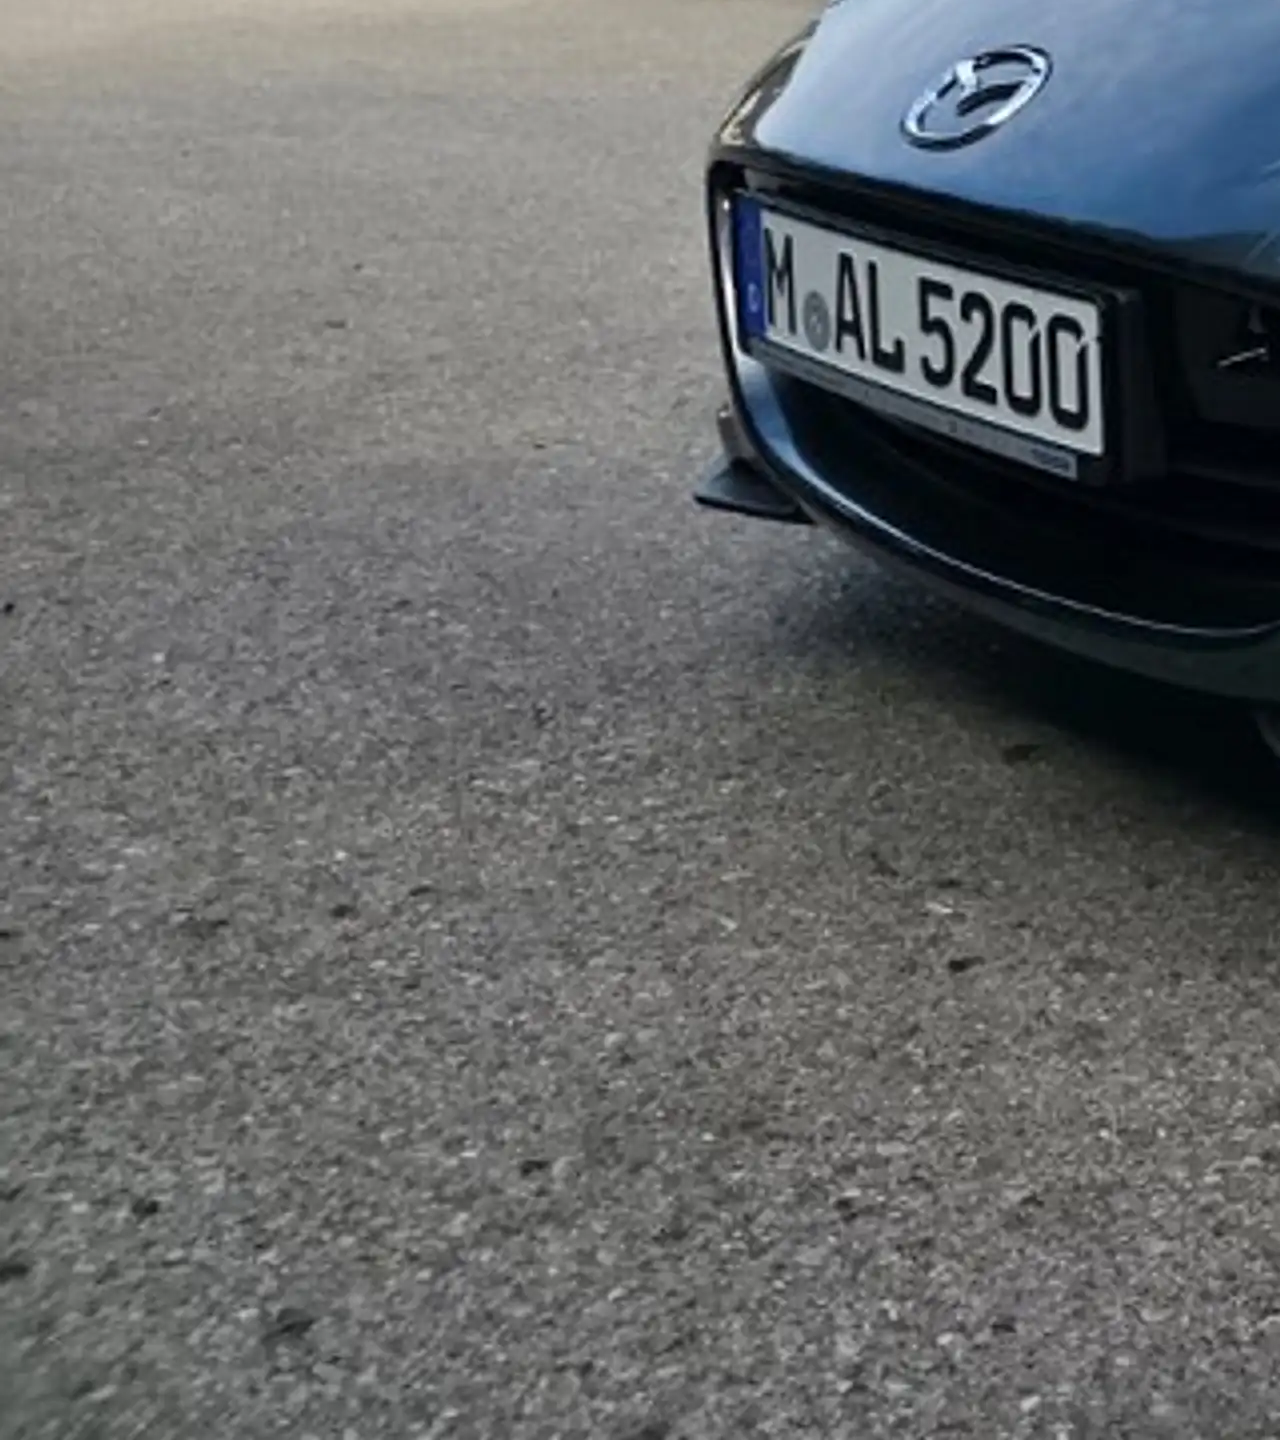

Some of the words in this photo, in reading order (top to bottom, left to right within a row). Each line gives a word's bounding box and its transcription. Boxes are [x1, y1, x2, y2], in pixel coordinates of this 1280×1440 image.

[764, 227, 797, 336] M
[836, 252, 905, 374] AL
[918, 277, 1090, 430] 5200
